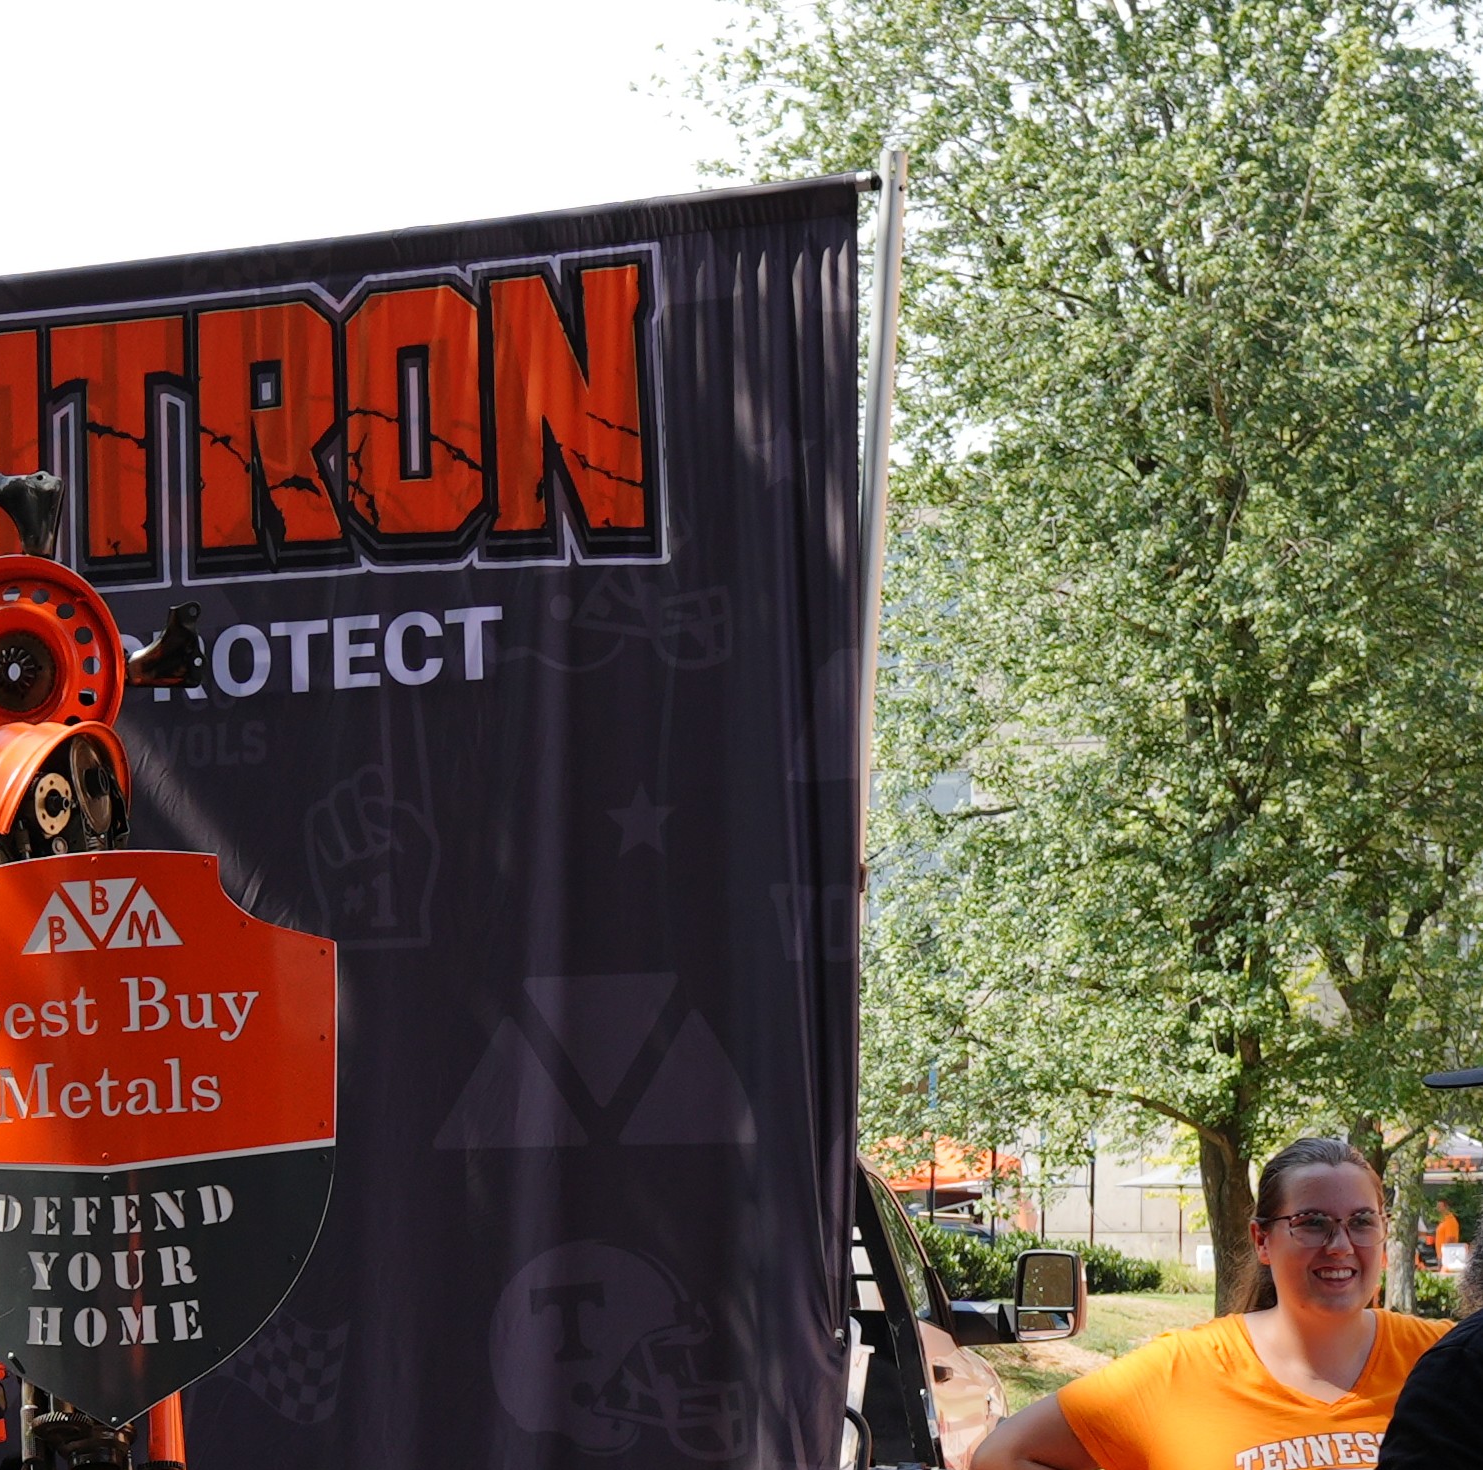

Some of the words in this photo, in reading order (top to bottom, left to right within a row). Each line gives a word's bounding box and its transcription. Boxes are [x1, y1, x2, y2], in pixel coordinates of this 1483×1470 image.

[120, 976, 260, 1042] Buy
[26, 1245, 199, 1293] YOUR
[25, 1300, 204, 1348] HOME
